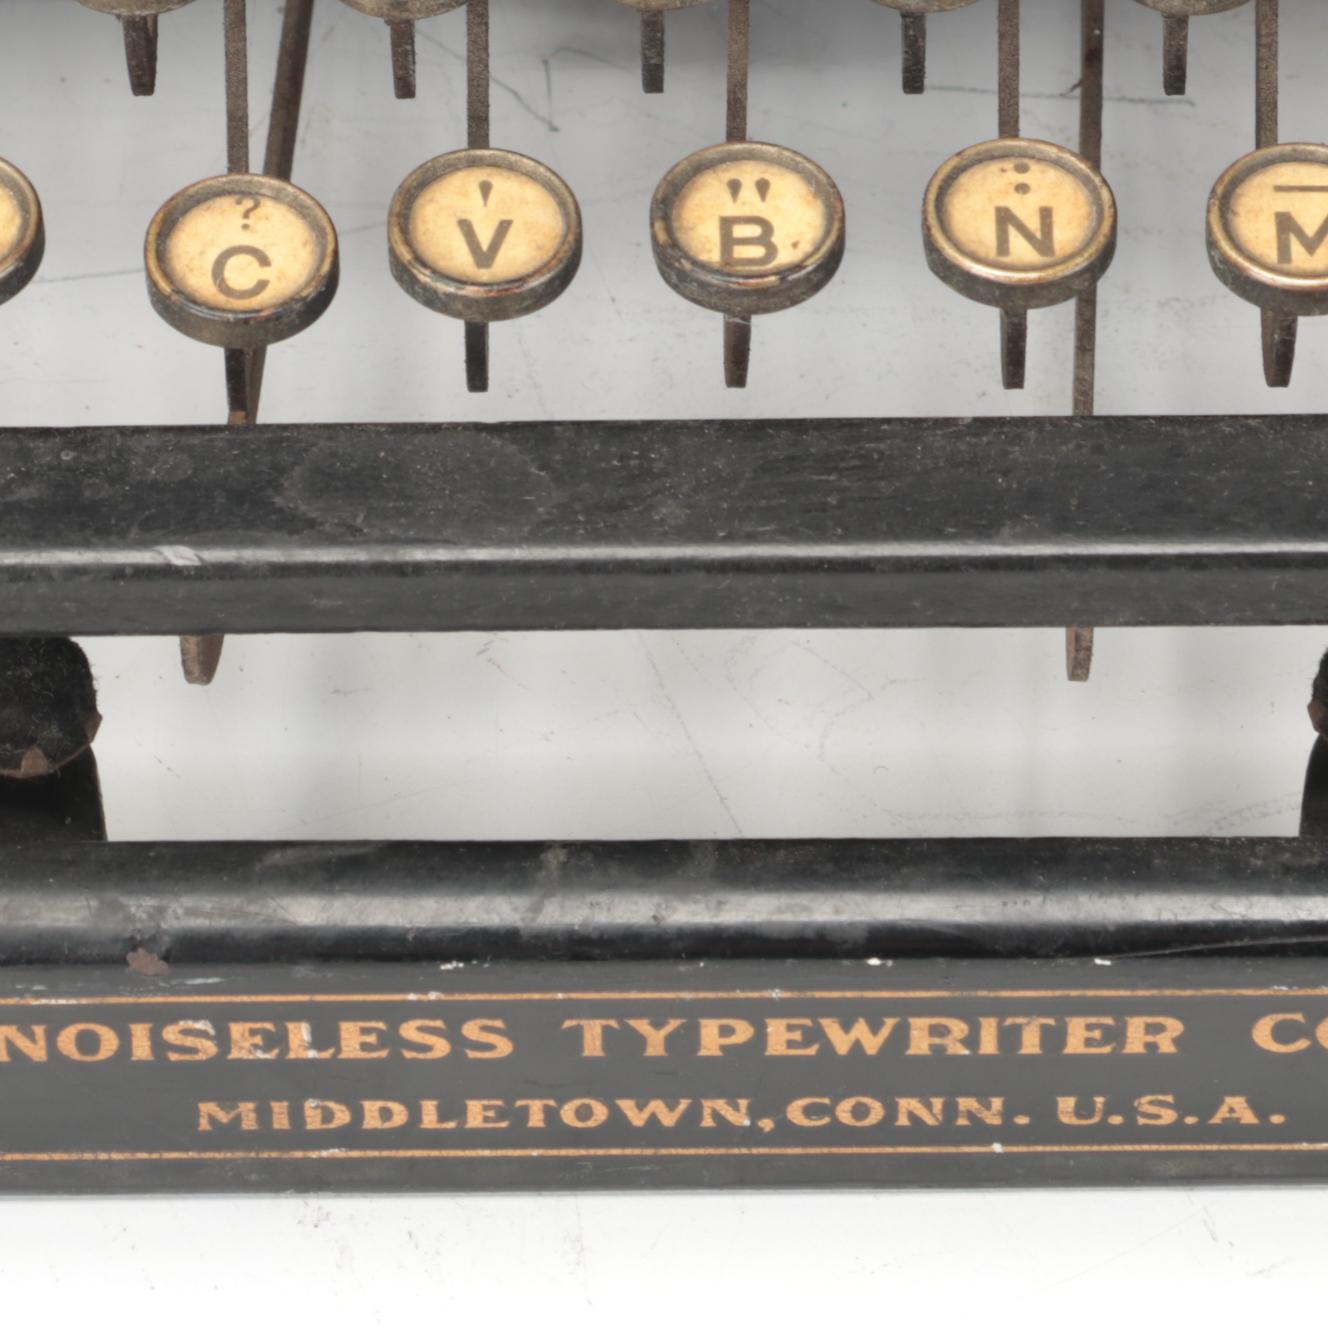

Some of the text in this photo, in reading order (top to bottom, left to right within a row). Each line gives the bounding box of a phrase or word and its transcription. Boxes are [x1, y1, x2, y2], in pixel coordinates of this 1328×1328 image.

[235, 196, 261, 231] ?
[994, 205, 1054, 259] N
[456, 219, 514, 270] V
[718, 215, 779, 268] B
[211, 244, 272, 300] C
[559, 1015, 1185, 1060] TYPEWRITER
[1056, 1095, 1287, 1128] U.S.A.
